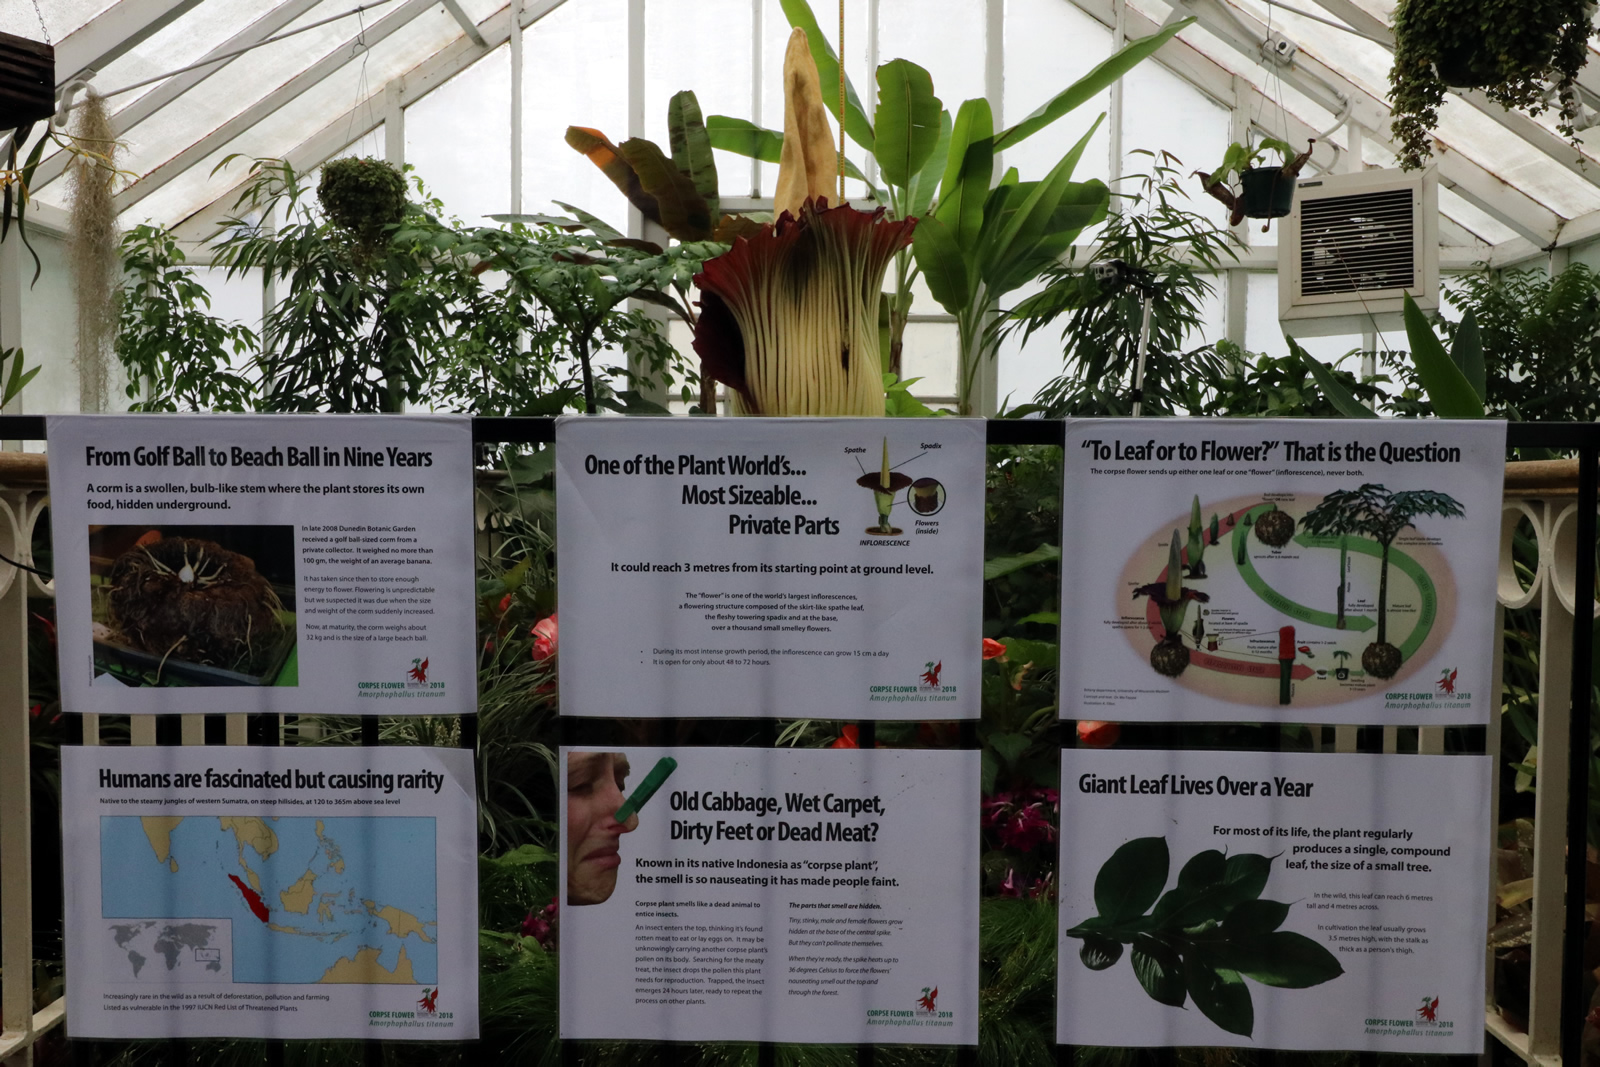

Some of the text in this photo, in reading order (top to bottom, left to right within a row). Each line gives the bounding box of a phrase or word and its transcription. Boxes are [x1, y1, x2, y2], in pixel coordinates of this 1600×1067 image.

[86, 445, 433, 467] From Golf Ball to Beach Ball in Nine Years
[1115, 439, 1155, 461] Leaf
[1156, 445, 1176, 461] or
[1178, 442, 1198, 461] to
[1283, 440, 1326, 462] That
[1328, 441, 1342, 462] is
[1344, 441, 1377, 462] the
[1379, 441, 1461, 465] Question
[585, 454, 620, 475] One
[623, 454, 643, 475] of
[644, 454, 675, 475] the
[678, 454, 726, 475] Plant
[87, 483, 95, 493] A
[125, 483, 134, 493] is
[144, 483, 188, 494] swollen,
[190, 483, 238, 493] bulb-like
[240, 485, 266, 493] stem
[268, 483, 301, 493] where
[303, 483, 321, 494] the
[323, 483, 351, 496] plant
[353, 485, 385, 494] stores
[387, 484, 400, 494] its
[682, 484, 817, 505] Most Sizeable...
[87, 499, 231, 512] food, hidden underground.
[729, 514, 840, 535] Private Parts
[611, 562, 934, 576] It could reach 3 metres from its starting point at ground level.
[99, 768, 444, 794] Humans are fascinated but causing rarity
[1079, 773, 1314, 798] Giant Leaf Lives Over a Year
[670, 791, 886, 818] Old Cabbage, Wet Carpet,
[671, 820, 879, 846] Dirty Feet or Dead Meat?
[1213, 826, 1413, 842] For most of its life, the plant regularly
[1293, 843, 1343, 856] produces
[1353, 844, 1389, 857] single,
[1391, 846, 1451, 858] compound
[636, 858, 673, 868] Known
[675, 858, 685, 868] in
[687, 858, 700, 868] its
[702, 858, 735, 868] native
[737, 859, 788, 869] Indonesia
[1286, 859, 1308, 870] leaf,
[1310, 859, 1329, 870] the
[1330, 860, 1351, 870] size
[1353, 860, 1365, 870] of
[1375, 861, 1404, 871] small
[1406, 863, 1432, 872] tree.
[635, 874, 653, 883] the
[655, 874, 683, 884] smell
[685, 874, 694, 884] is
[710, 875, 768, 887] nauseating
[771, 876, 778, 885] it
[780, 875, 799, 885] has
[801, 876, 831, 886] made
[833, 876, 870, 888] people
[871, 876, 899, 887] faint.
